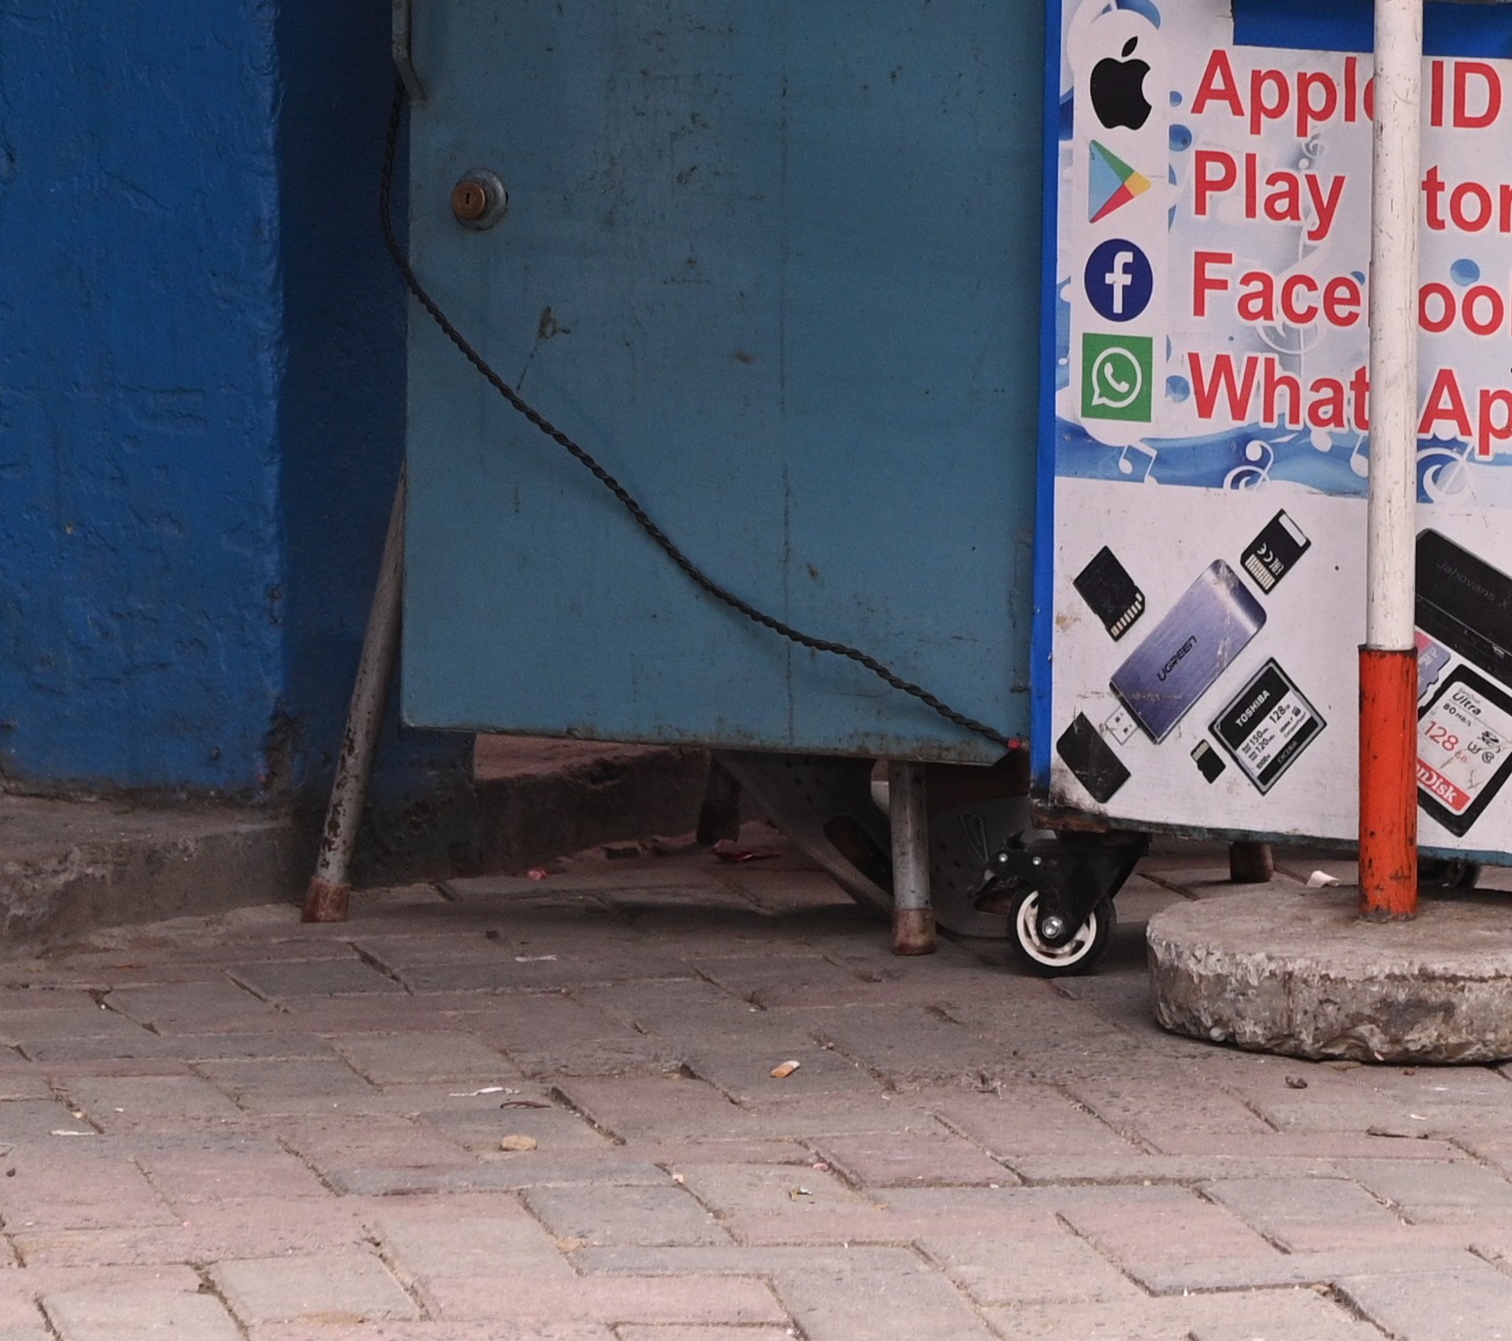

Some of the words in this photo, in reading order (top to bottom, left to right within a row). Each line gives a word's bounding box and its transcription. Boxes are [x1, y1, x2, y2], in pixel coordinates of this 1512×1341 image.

[1429, 60, 1502, 129] ID
[1194, 149, 1347, 242] Play
[1157, 635, 1198, 683] UGREEN
[1235, 689, 1271, 729] TOSHIBA
[1451, 691, 1482, 716] Ultra
[1424, 720, 1459, 752] 128
[1418, 761, 1458, 805] nDisk
